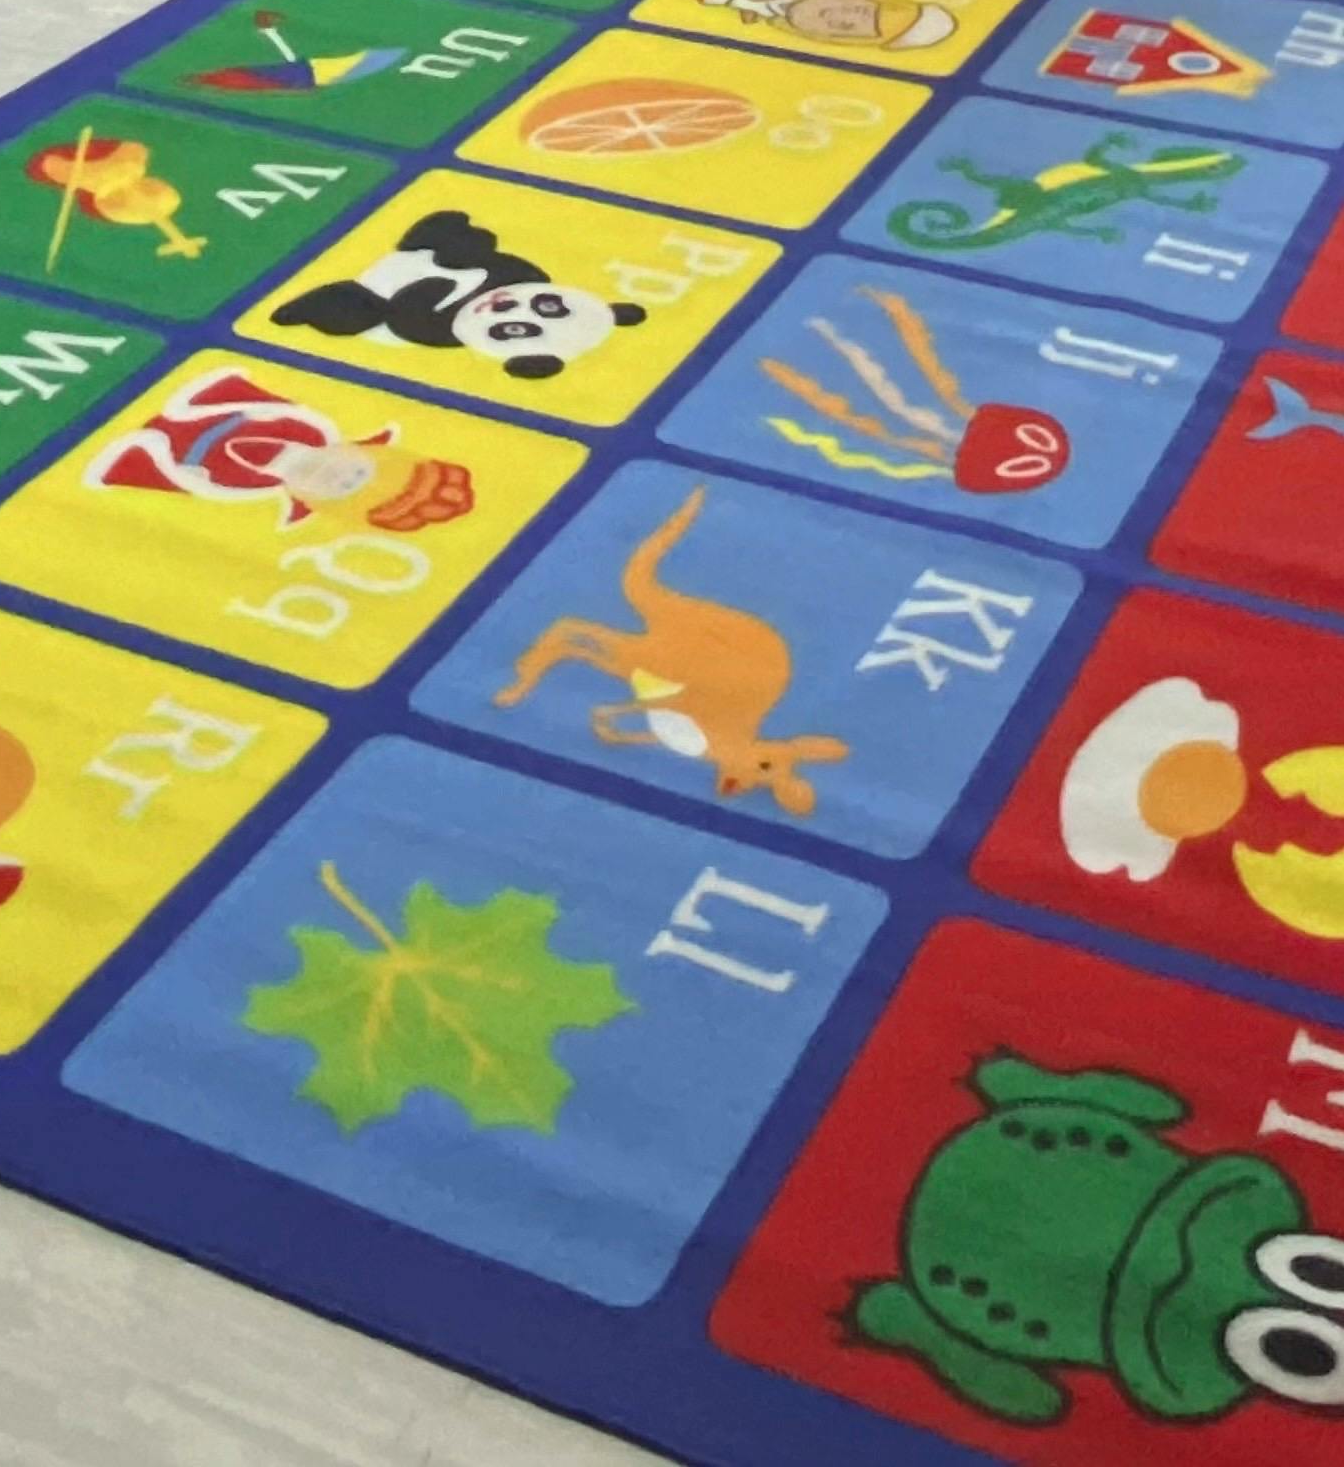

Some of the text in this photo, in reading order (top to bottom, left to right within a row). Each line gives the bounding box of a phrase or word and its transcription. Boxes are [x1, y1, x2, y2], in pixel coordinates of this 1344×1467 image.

[400, 27, 530, 79] Uu
[216, 163, 347, 220] Vv
[1142, 232, 1250, 281] Ii
[1039, 326, 1180, 386] Jj
[225, 533, 433, 640] Qq
[855, 569, 1035, 692] Kk
[83, 692, 263, 819] Rr
[645, 865, 830, 992] Ll
